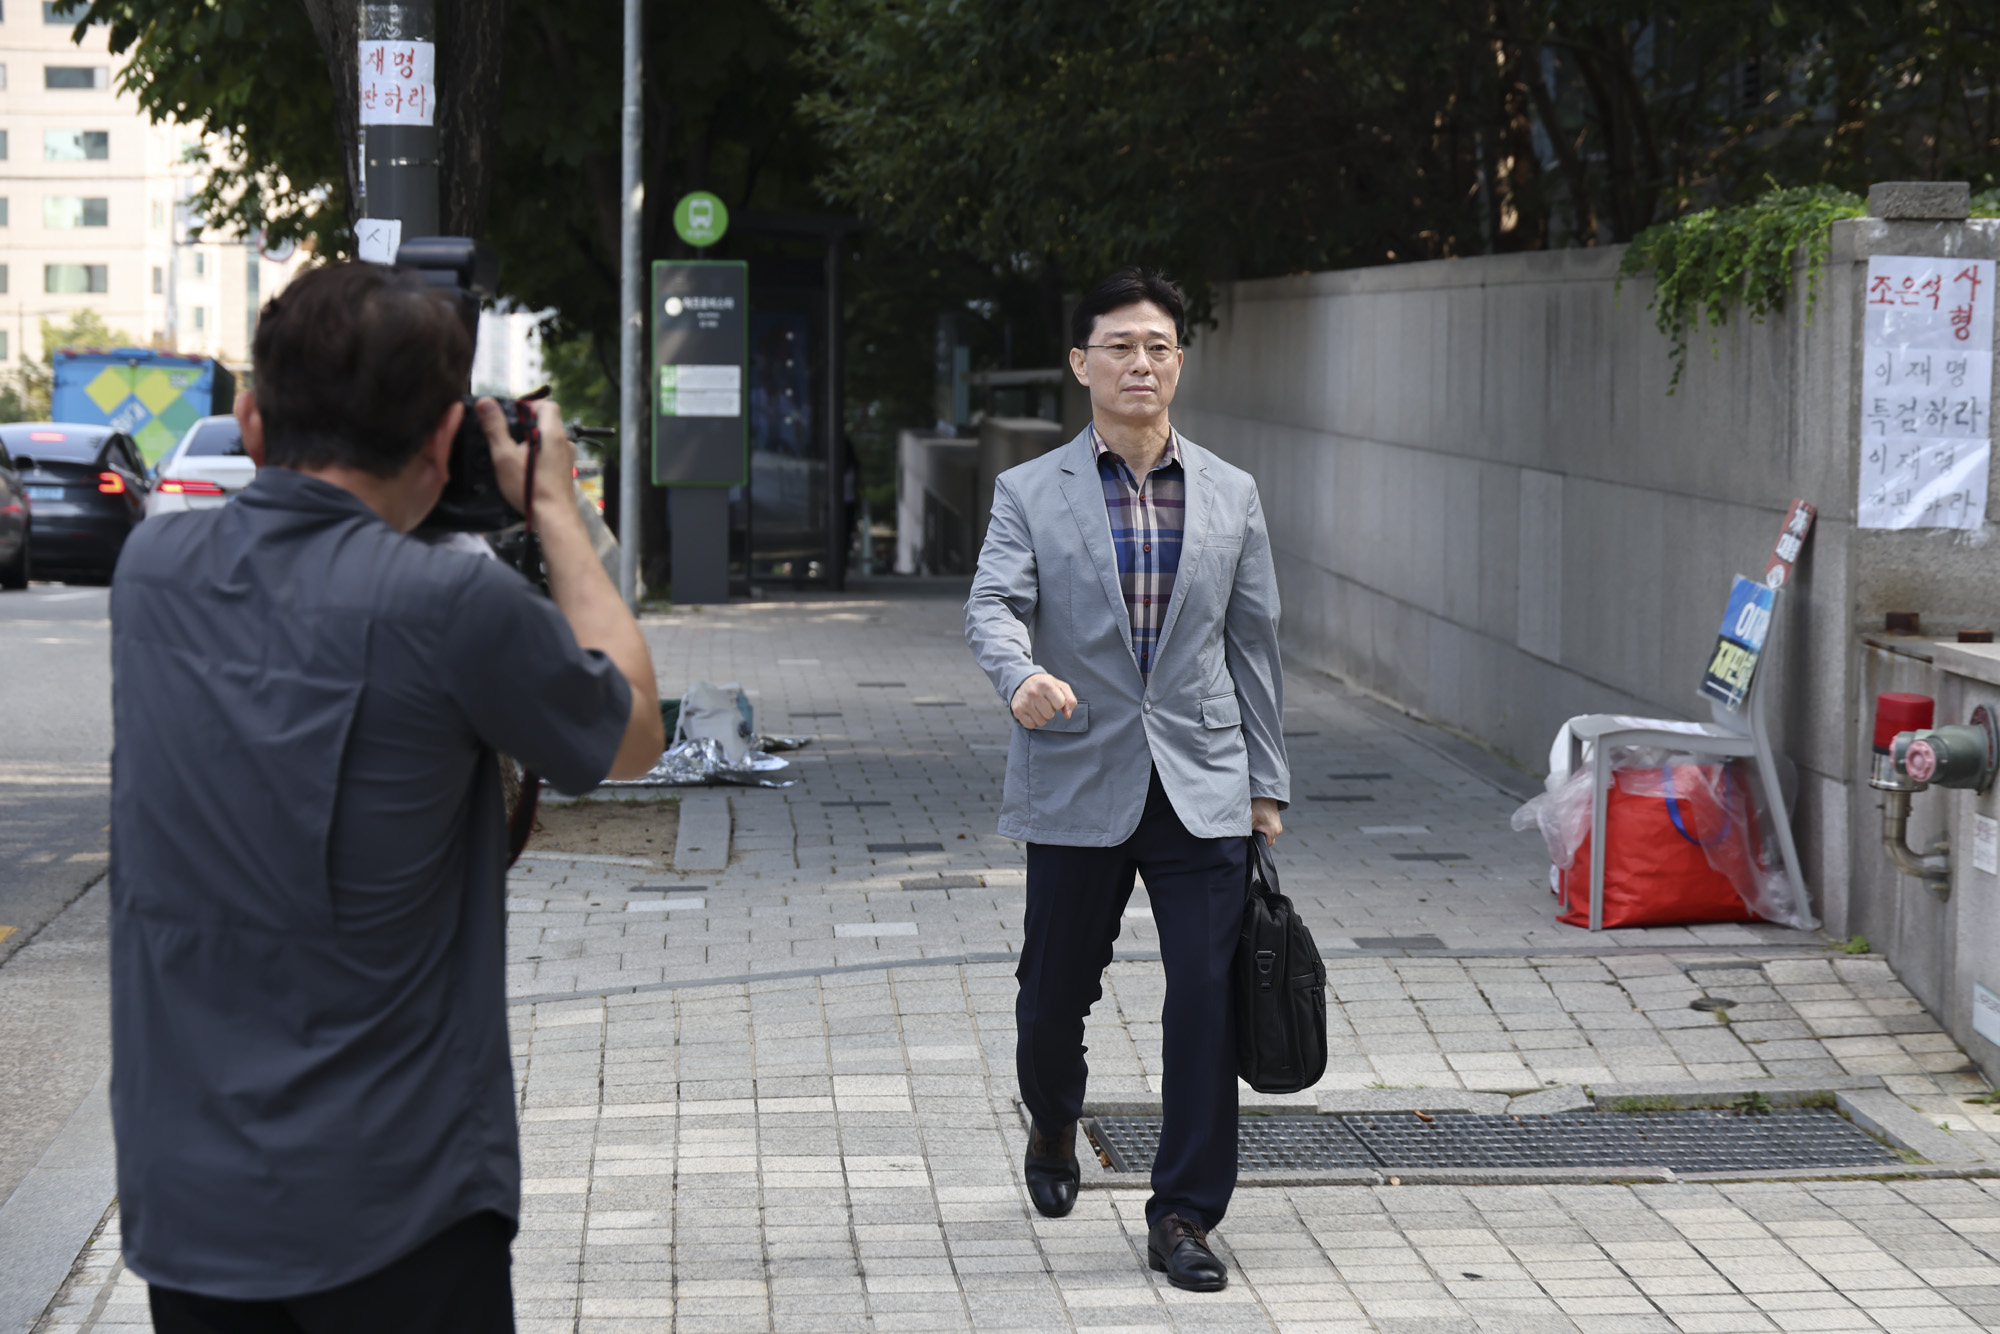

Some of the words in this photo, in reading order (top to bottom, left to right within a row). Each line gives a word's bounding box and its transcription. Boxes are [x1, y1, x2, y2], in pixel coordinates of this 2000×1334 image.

[360, 46, 416, 79] 재명
[360, 82, 427, 118] 판하라
[1869, 273, 1942, 311] 조은석
[1867, 395, 1983, 436] 특검하라
